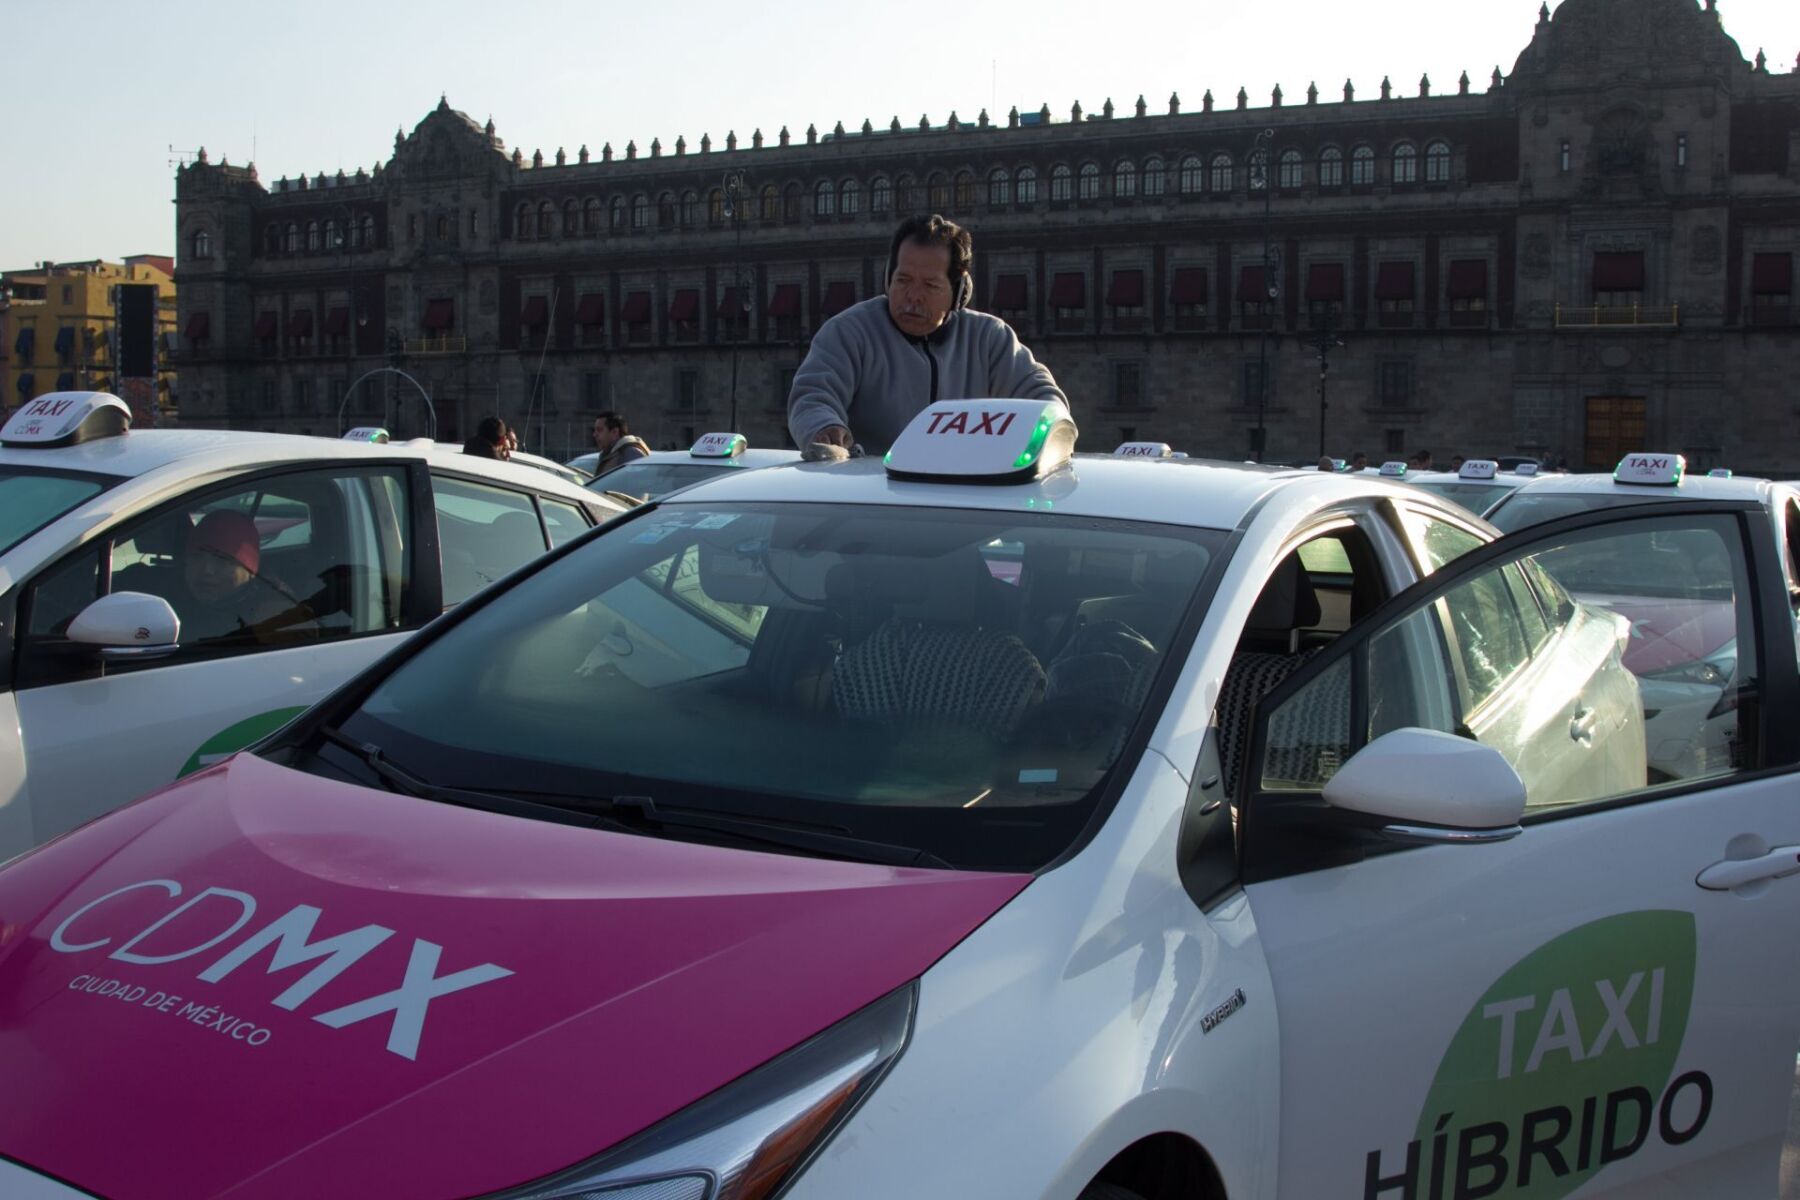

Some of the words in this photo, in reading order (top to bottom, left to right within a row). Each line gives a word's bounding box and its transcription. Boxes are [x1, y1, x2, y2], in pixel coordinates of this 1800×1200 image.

[25, 400, 74, 416] TAXI
[926, 412, 1017, 435] TAXI
[702, 436, 728, 445] TAXI
[1121, 447, 1153, 456] TAXI
[1630, 458, 1668, 469] TAXI
[50, 879, 516, 1062] CDMX
[68, 974, 146, 1002] CIUDAD
[142, 991, 182, 1013] DE
[175, 1005, 272, 1046] MÉXICO
[1201, 988, 1247, 1035] HYBRID
[1483, 967, 1665, 1079] TAXI
[1364, 1070, 1713, 1200] HÍBRIDO
